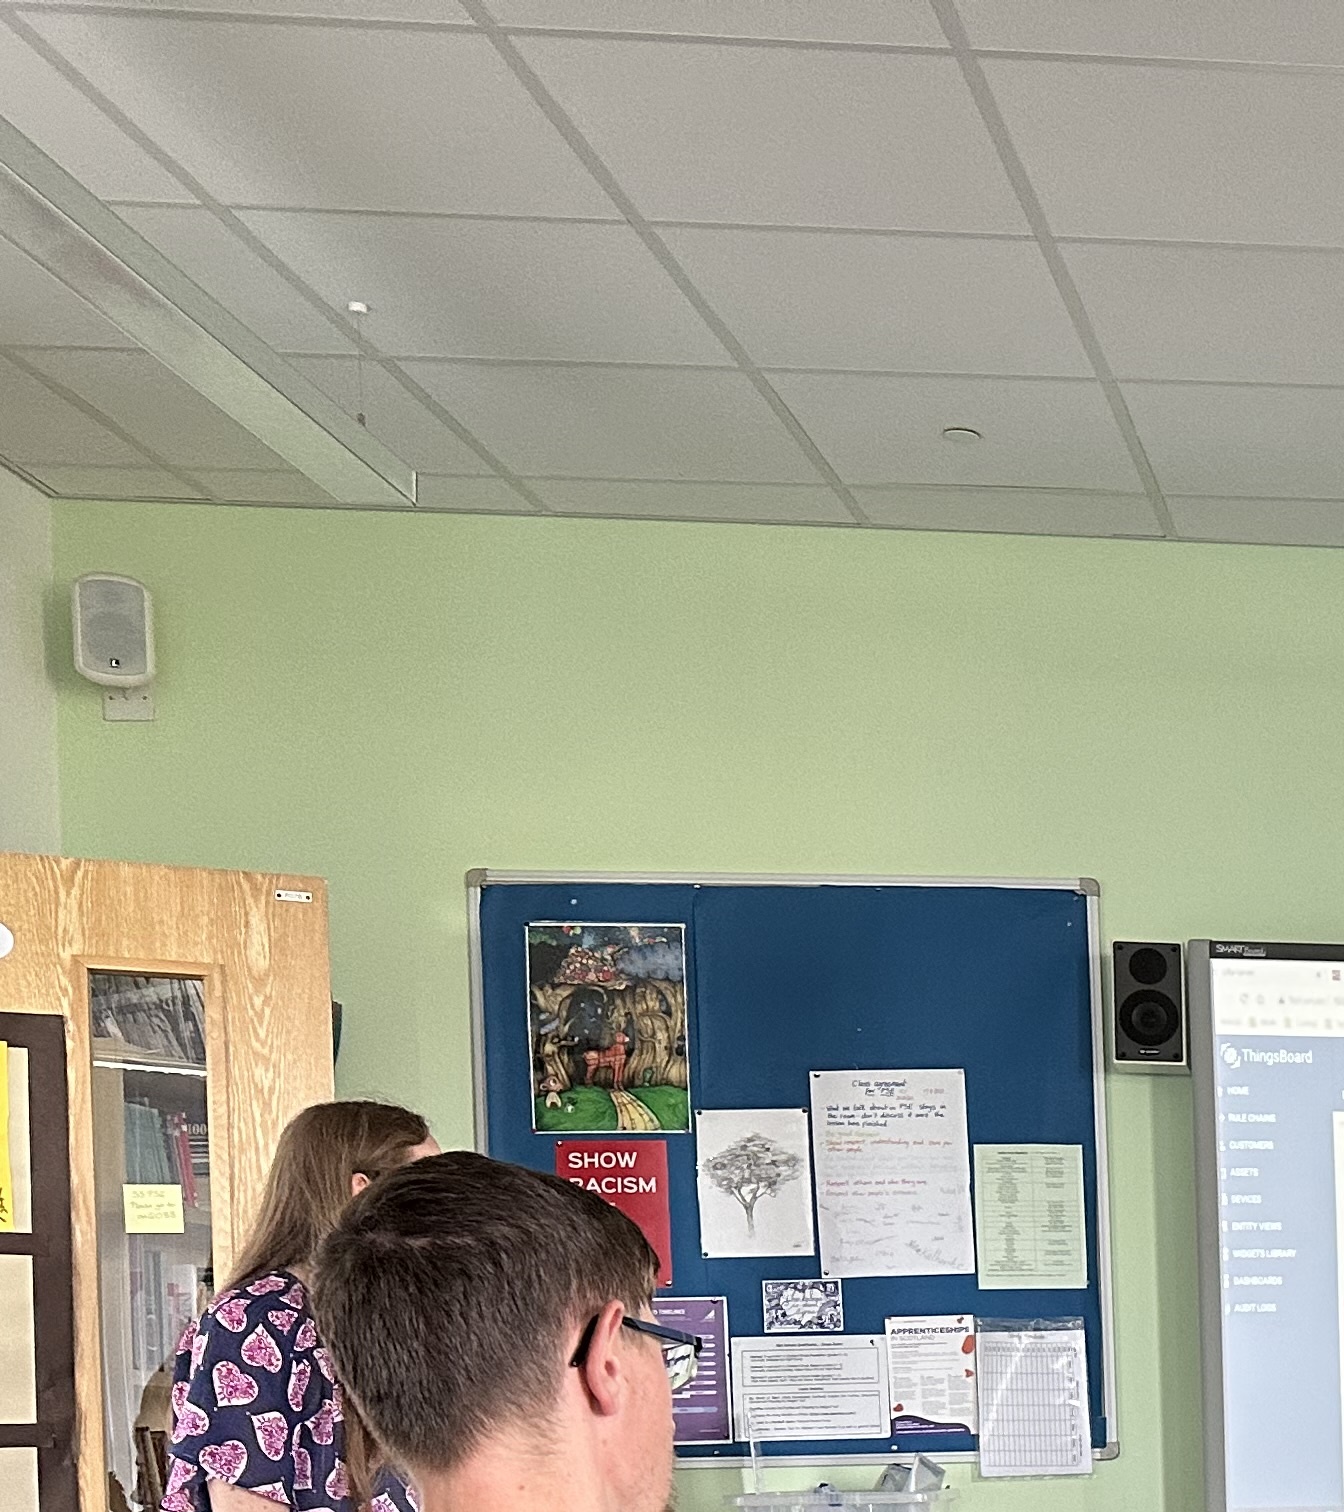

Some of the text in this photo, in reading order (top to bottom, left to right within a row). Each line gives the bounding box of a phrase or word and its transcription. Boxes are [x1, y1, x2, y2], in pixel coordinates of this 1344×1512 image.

[1215, 944, 1245, 954] SMART
[1241, 1048, 1313, 1066] ThingsBoard
[568, 1151, 638, 1169] SHOW
[890, 1326, 970, 1335] APPRENTICESHIPS
